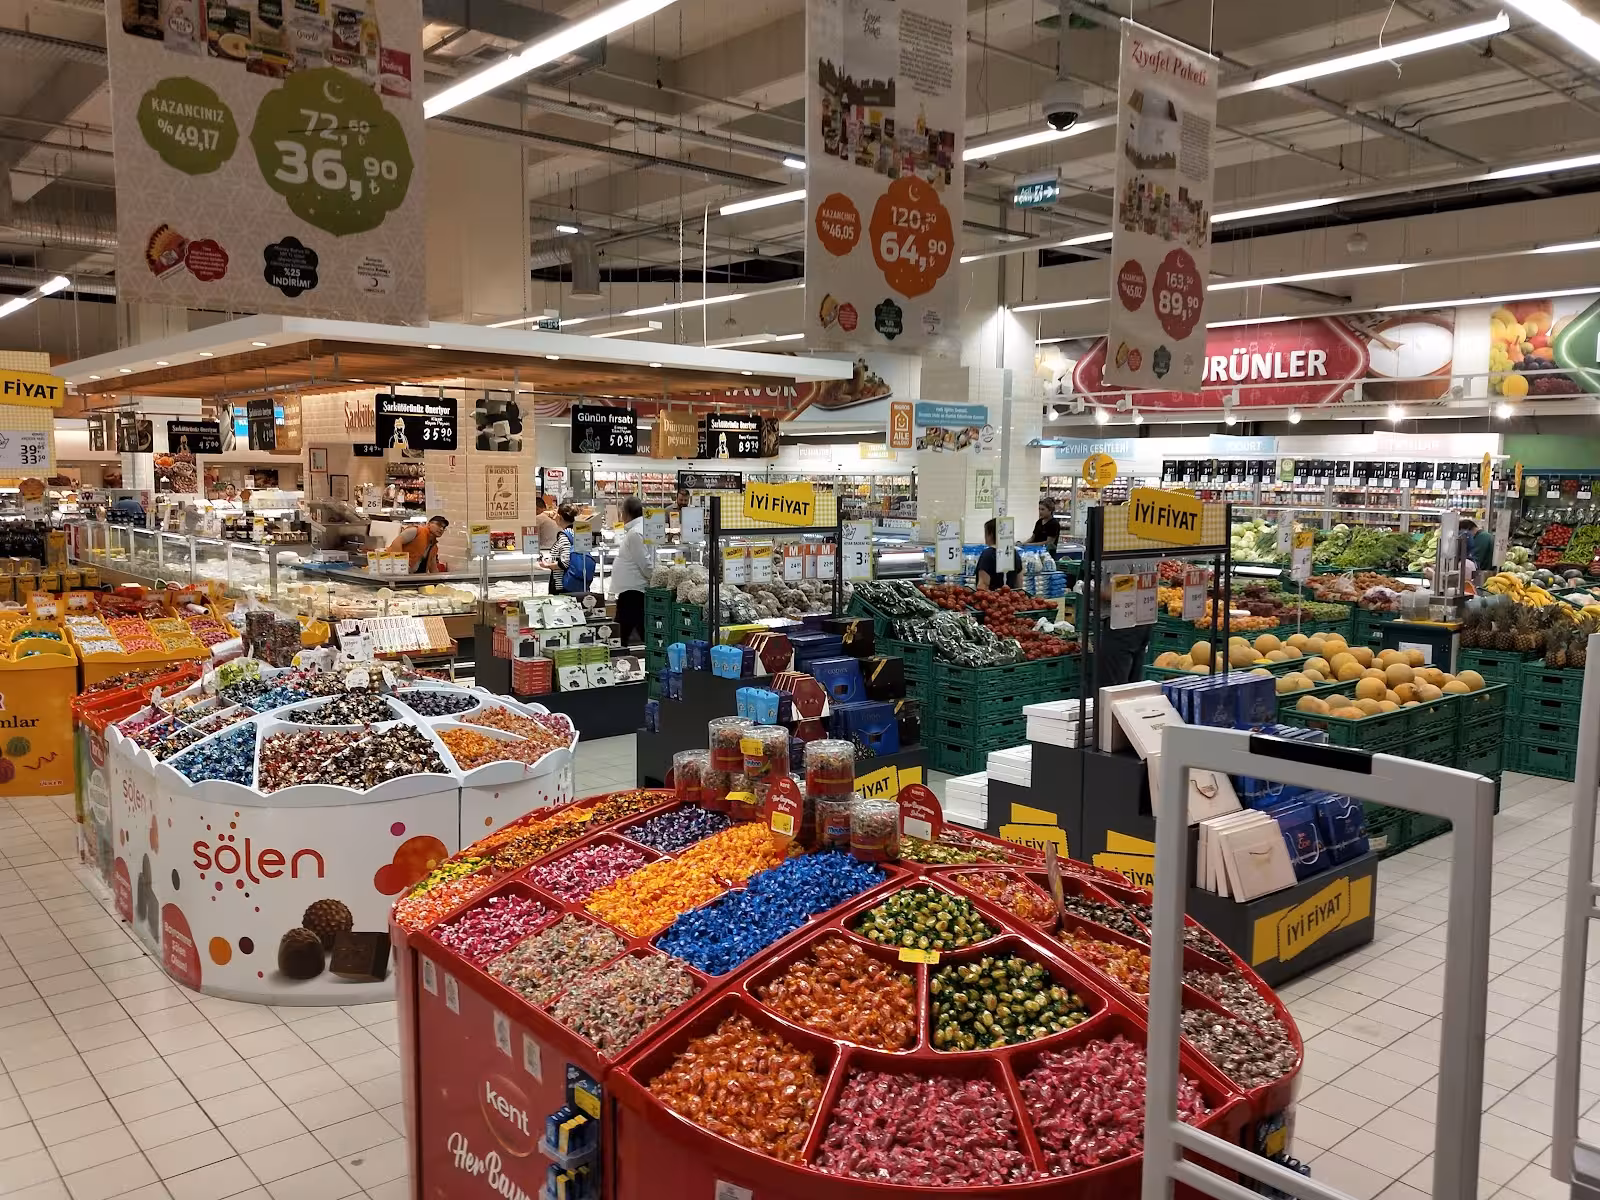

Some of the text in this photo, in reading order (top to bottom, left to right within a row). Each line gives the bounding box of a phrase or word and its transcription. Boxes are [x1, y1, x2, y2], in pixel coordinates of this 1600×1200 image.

[1131, 39, 1207, 87] Ziyafet Paketi
[151, 98, 225, 123] KAZANCINIZ
[157, 119, 219, 152] %49,17
[822, 208, 856, 224] KAZANCINIZ
[822, 219, 854, 241] %46,05
[283, 267, 300, 277] %25
[4, 379, 58, 399] FİYAT
[577, 412, 633, 424] Günün fırsatı
[664, 418, 695, 434] Dünyanın
[668, 434, 691, 447] peyniri
[894, 432, 910, 440] AİLE
[489, 501, 515, 511] TAZE
[750, 491, 810, 516] İYİ FİYAT
[1135, 498, 1198, 531] İYİ FİYAT
[1287, 892, 1342, 946] İYİ FİYAT
[485, 1080, 530, 1137] kent
